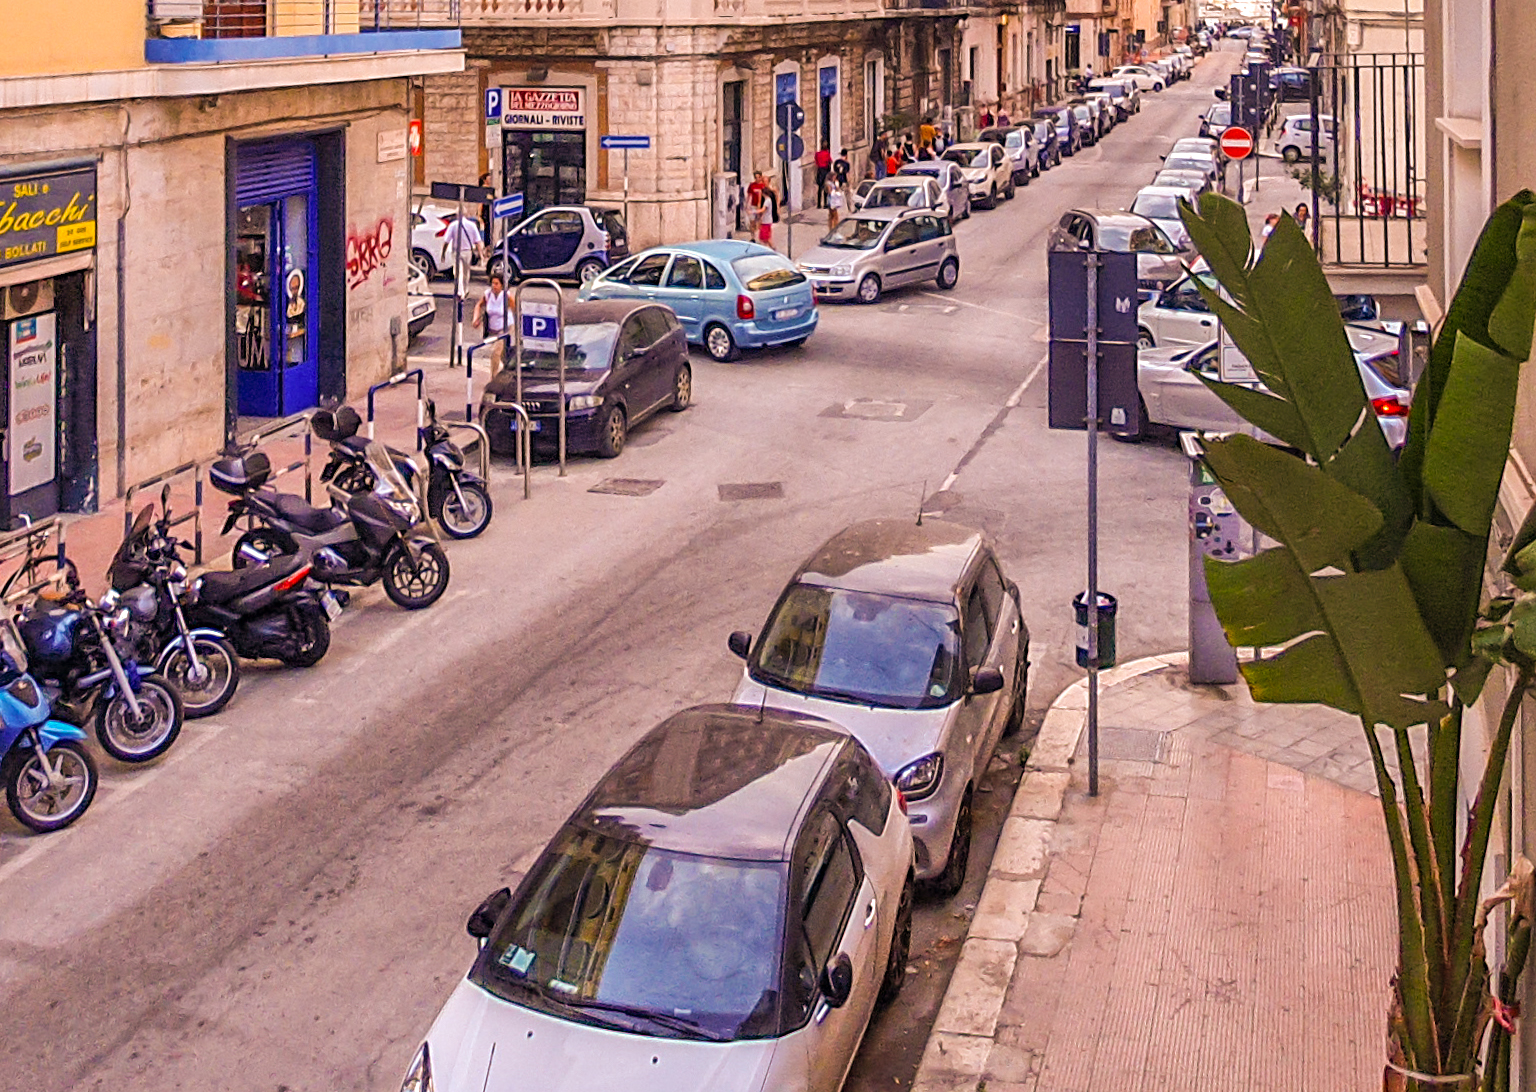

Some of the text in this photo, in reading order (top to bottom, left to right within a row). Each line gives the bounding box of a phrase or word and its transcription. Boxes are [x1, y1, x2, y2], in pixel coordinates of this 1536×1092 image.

[488, 91, 499, 116] P
[525, 92, 576, 102] GAZZETTA
[504, 114, 544, 125] GIORNALI
[552, 115, 584, 126] RIVISTE
[14, 183, 38, 199] SALI
[5, 241, 46, 261] BOLLATI
[532, 318, 546, 336] P
